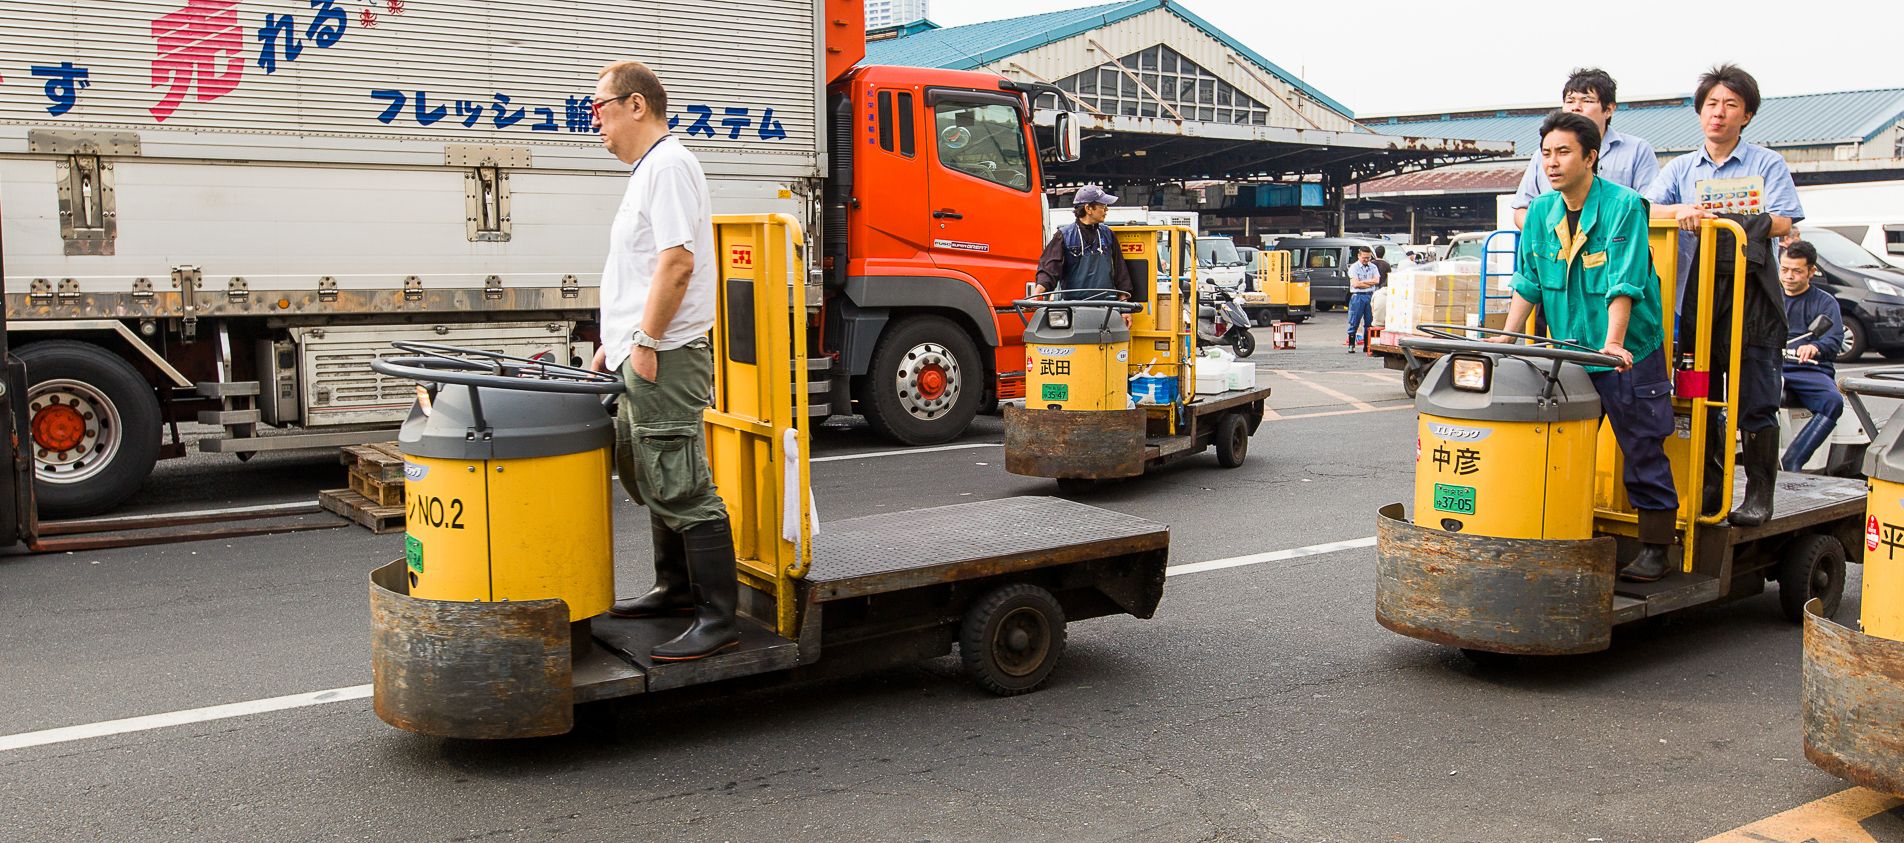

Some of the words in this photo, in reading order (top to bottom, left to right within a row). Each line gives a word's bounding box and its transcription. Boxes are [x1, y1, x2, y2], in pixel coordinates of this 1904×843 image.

[370, 89, 787, 140] フレッシュ輸ステム
[1040, 359, 1070, 376] 武田
[1432, 444, 1481, 475] 中彦
[1441, 496, 1472, 511] 37-05
[1881, 522, 1904, 560] 平
